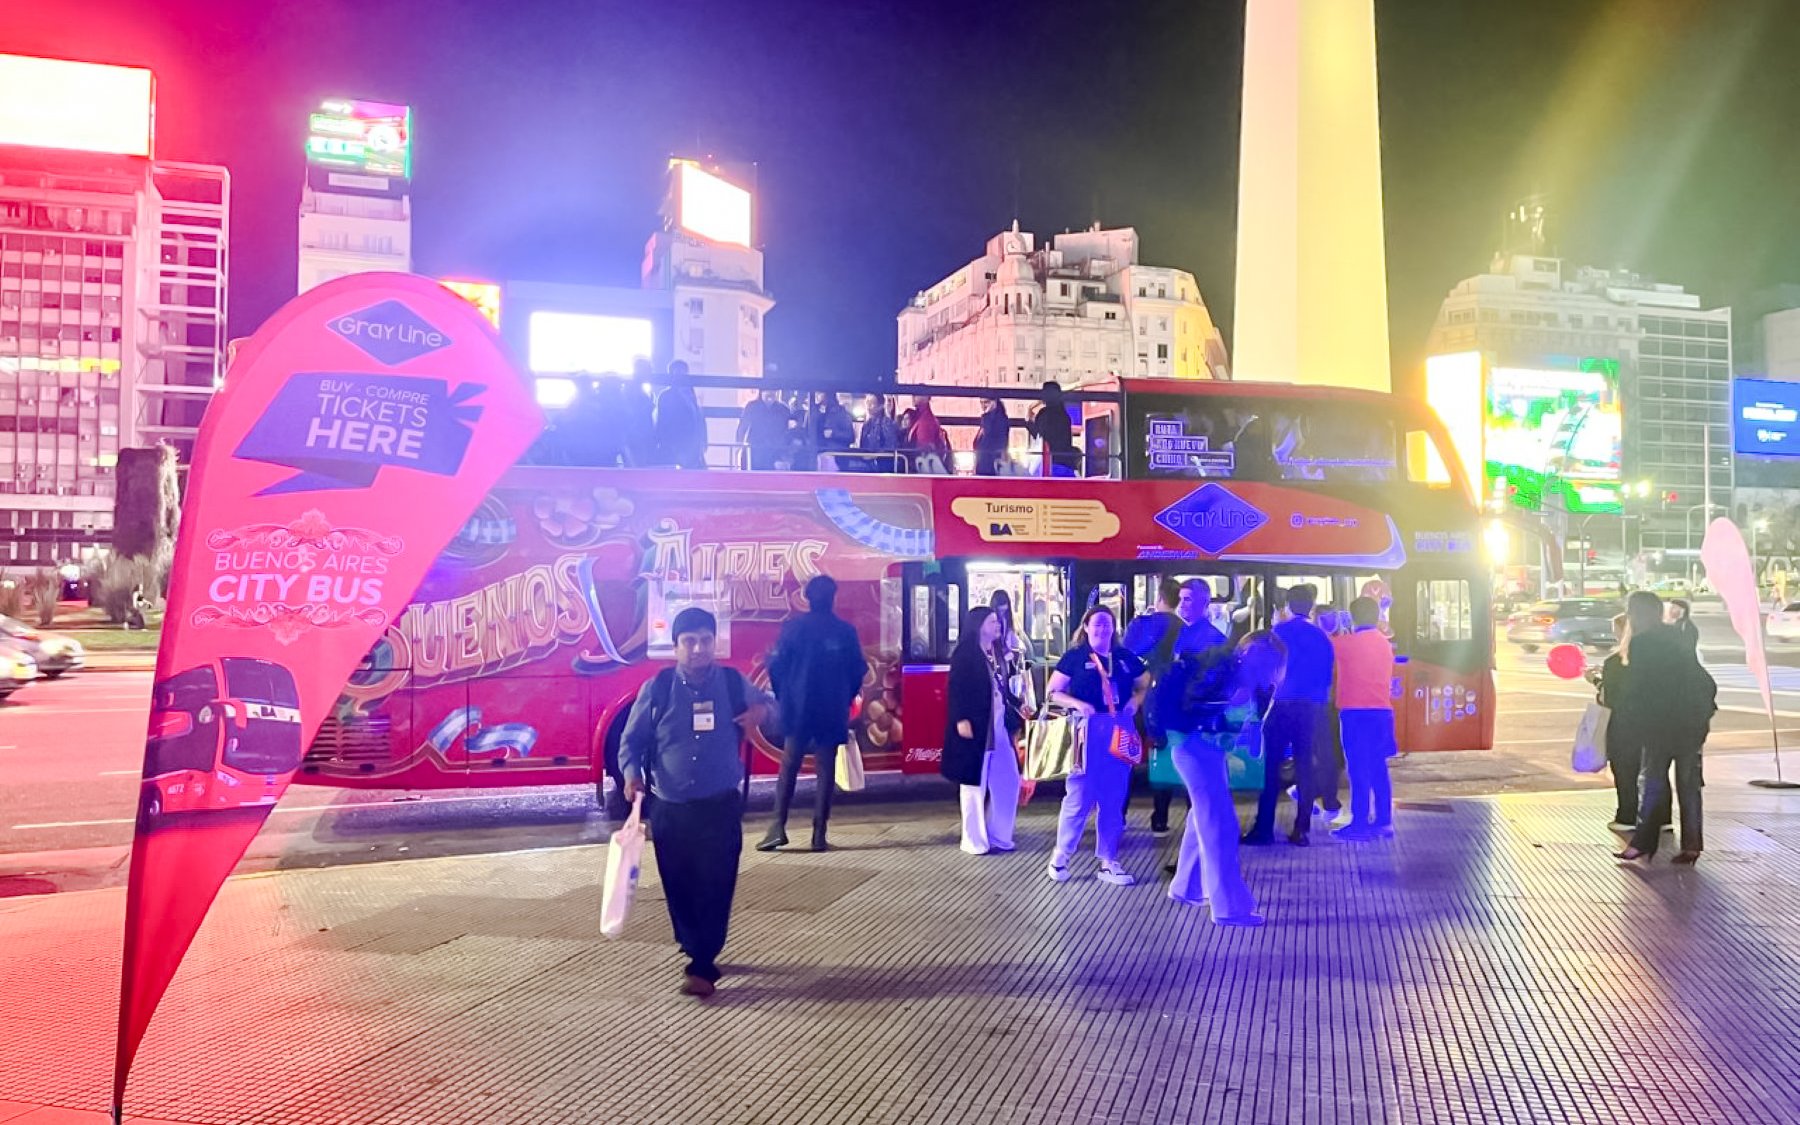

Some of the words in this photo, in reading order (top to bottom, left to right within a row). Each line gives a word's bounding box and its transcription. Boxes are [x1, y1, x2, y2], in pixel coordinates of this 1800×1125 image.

[338, 316, 395, 342] Gray
[398, 324, 443, 348] Line
[319, 379, 354, 394] BUY
[365, 385, 429, 405] COMPRE
[317, 393, 429, 428] TICKETS
[305, 417, 424, 459] HERE
[985, 502, 1034, 514] Turismo
[1166, 510, 1217, 529] Gray
[1219, 507, 1258, 528] Line
[990, 523, 1013, 536] BA
[214, 551, 316, 571] BUENOS
[323, 554, 389, 575] AIRES
[648, 517, 829, 620] AIRES
[208, 573, 300, 603] CITY
[307, 575, 384, 606] BUS
